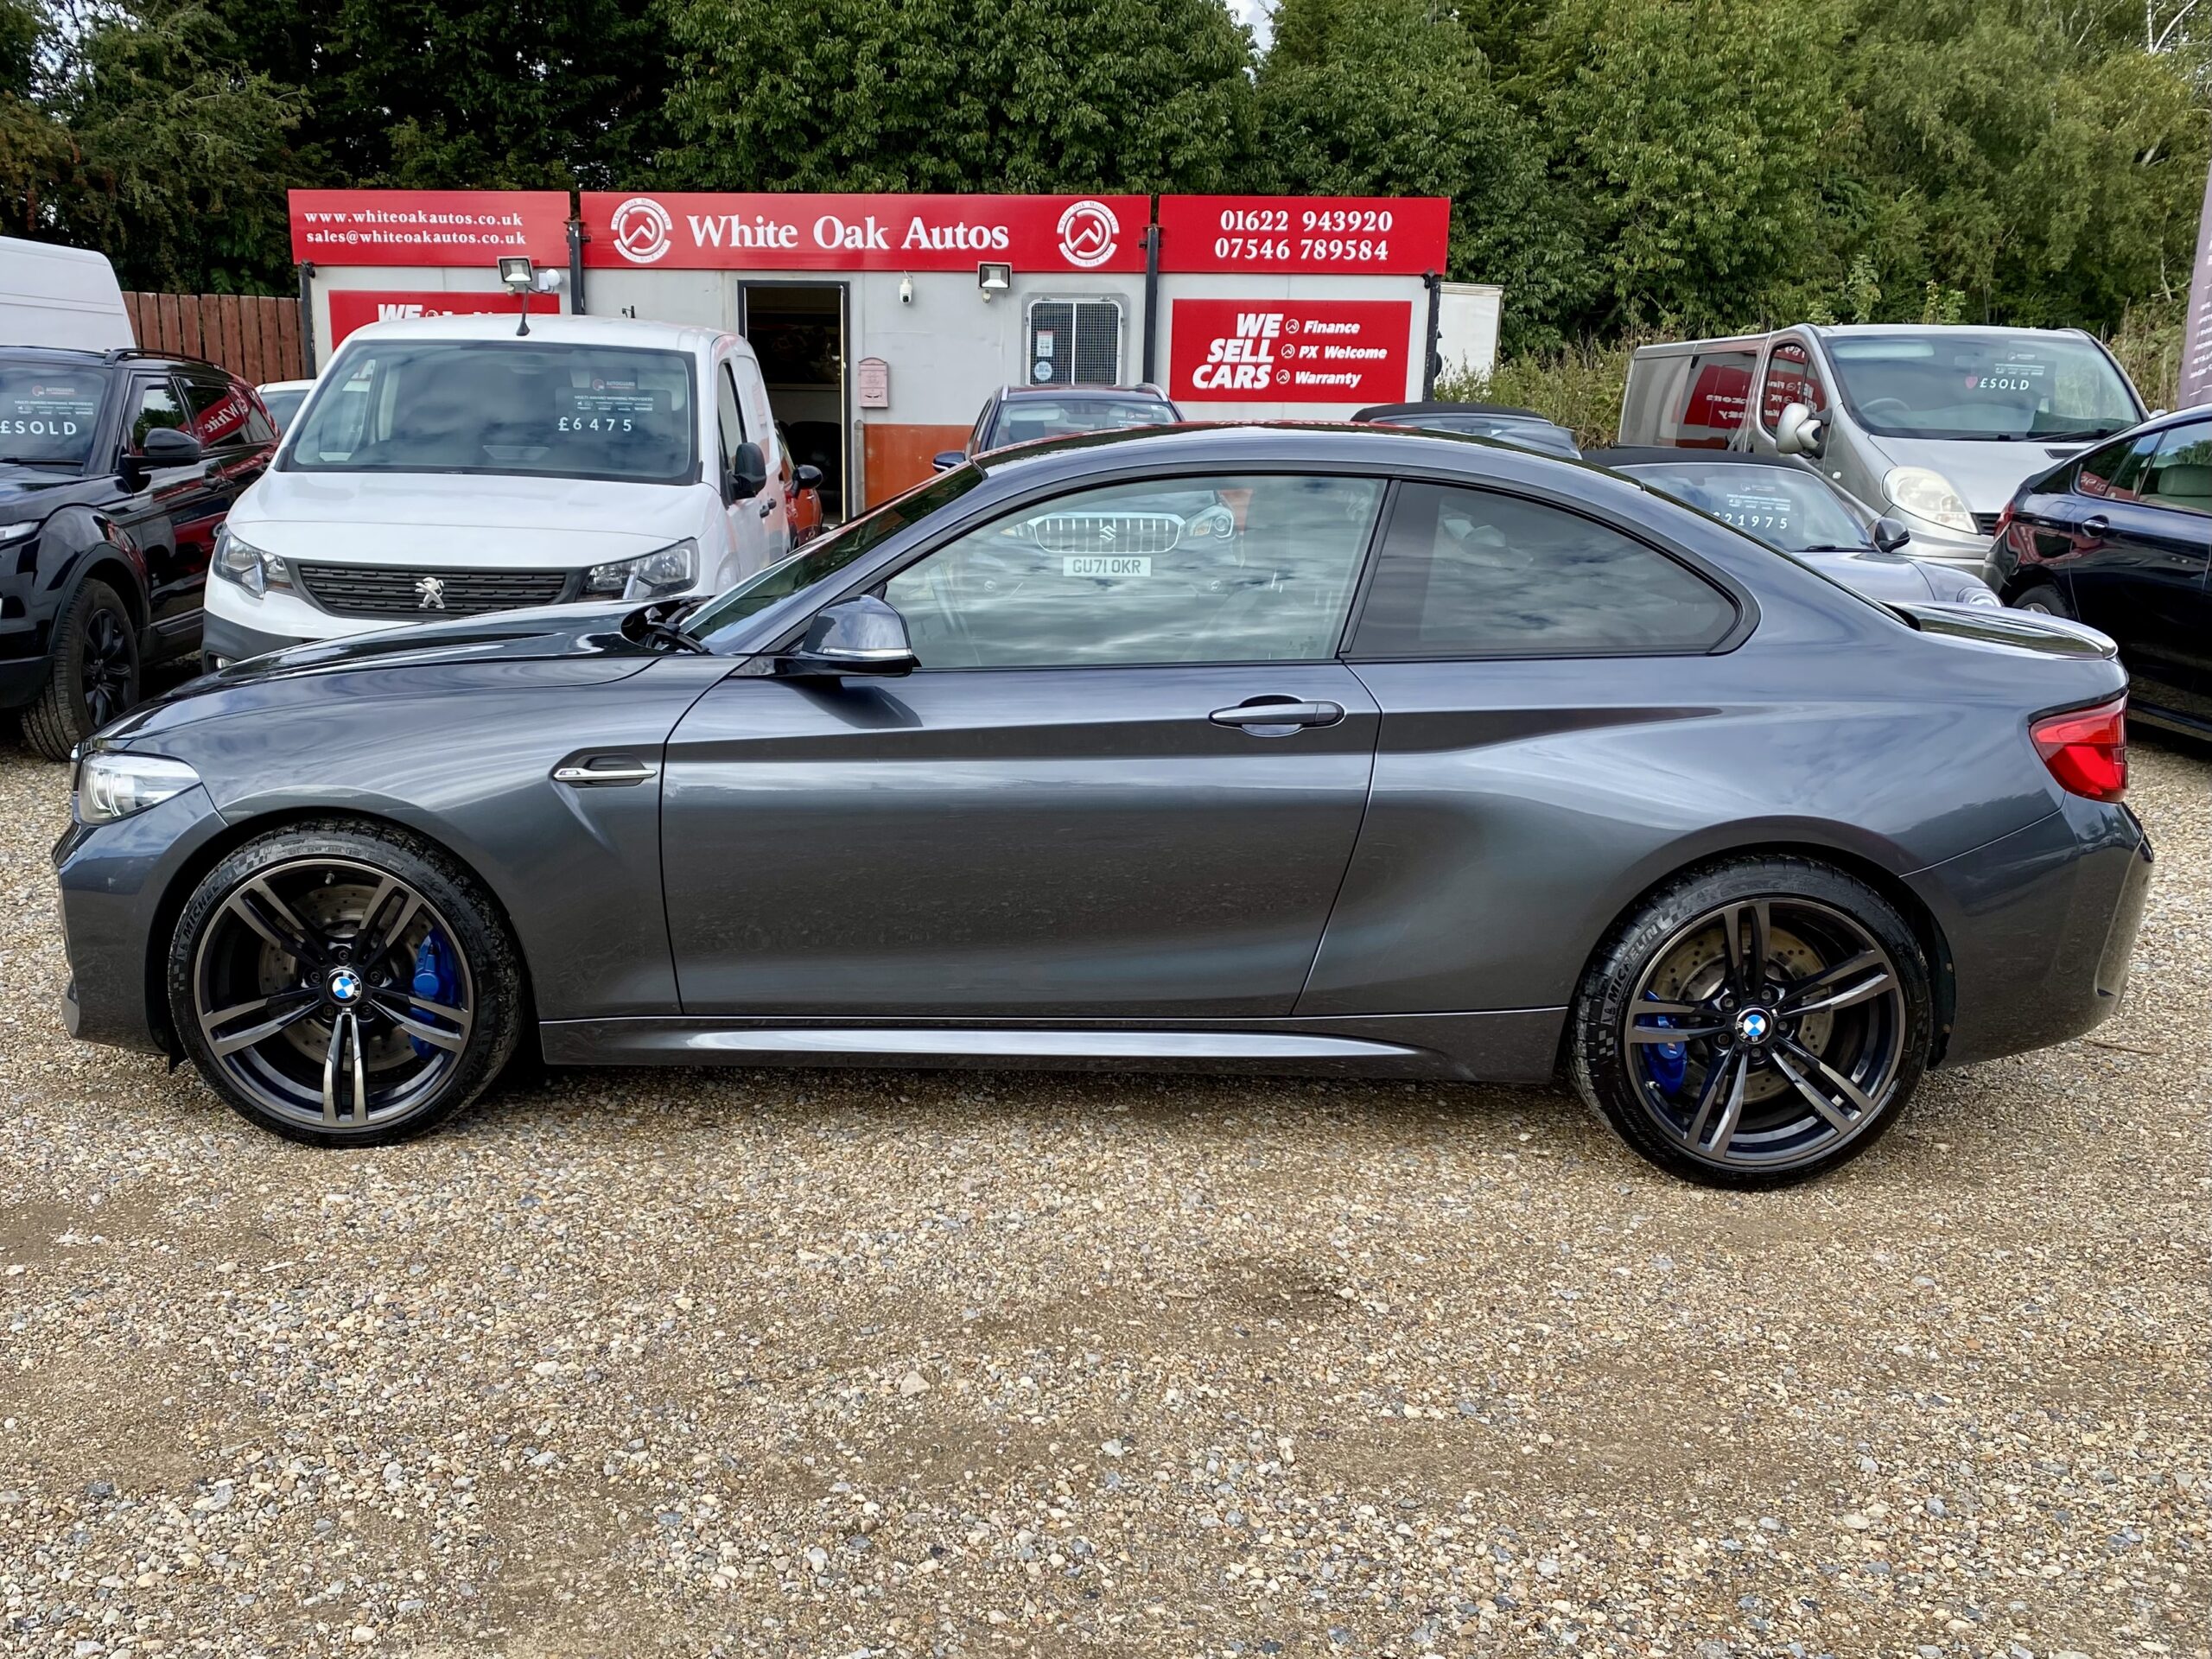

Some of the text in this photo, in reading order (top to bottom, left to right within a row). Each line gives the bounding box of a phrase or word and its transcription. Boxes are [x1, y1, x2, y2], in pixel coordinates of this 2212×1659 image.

[304, 209, 524, 226] www.whiteoakautos.co.uk
[1220, 210, 1393, 232] 01622 943920
[306, 229, 526, 245] sales@whiteoakautos.co.uk
[686, 214, 1009, 250] White Oak Autos
[1215, 238, 1389, 260] 07546 789584
[1236, 314, 1284, 338] WE
[1303, 321, 1360, 334] Finance
[1207, 338, 1274, 363] SELL
[1299, 346, 1387, 359] PX Welcome
[1192, 365, 1272, 389] CARS
[1295, 372, 1362, 388] Warranty
[1980, 378, 2029, 391] £SOLD
[0, 420, 77, 435] £SOLD
[558, 416, 632, 432] £6475
[1073, 559, 1141, 574] GU71 OKR
[1608, 924, 1658, 1004] MICHELIN
